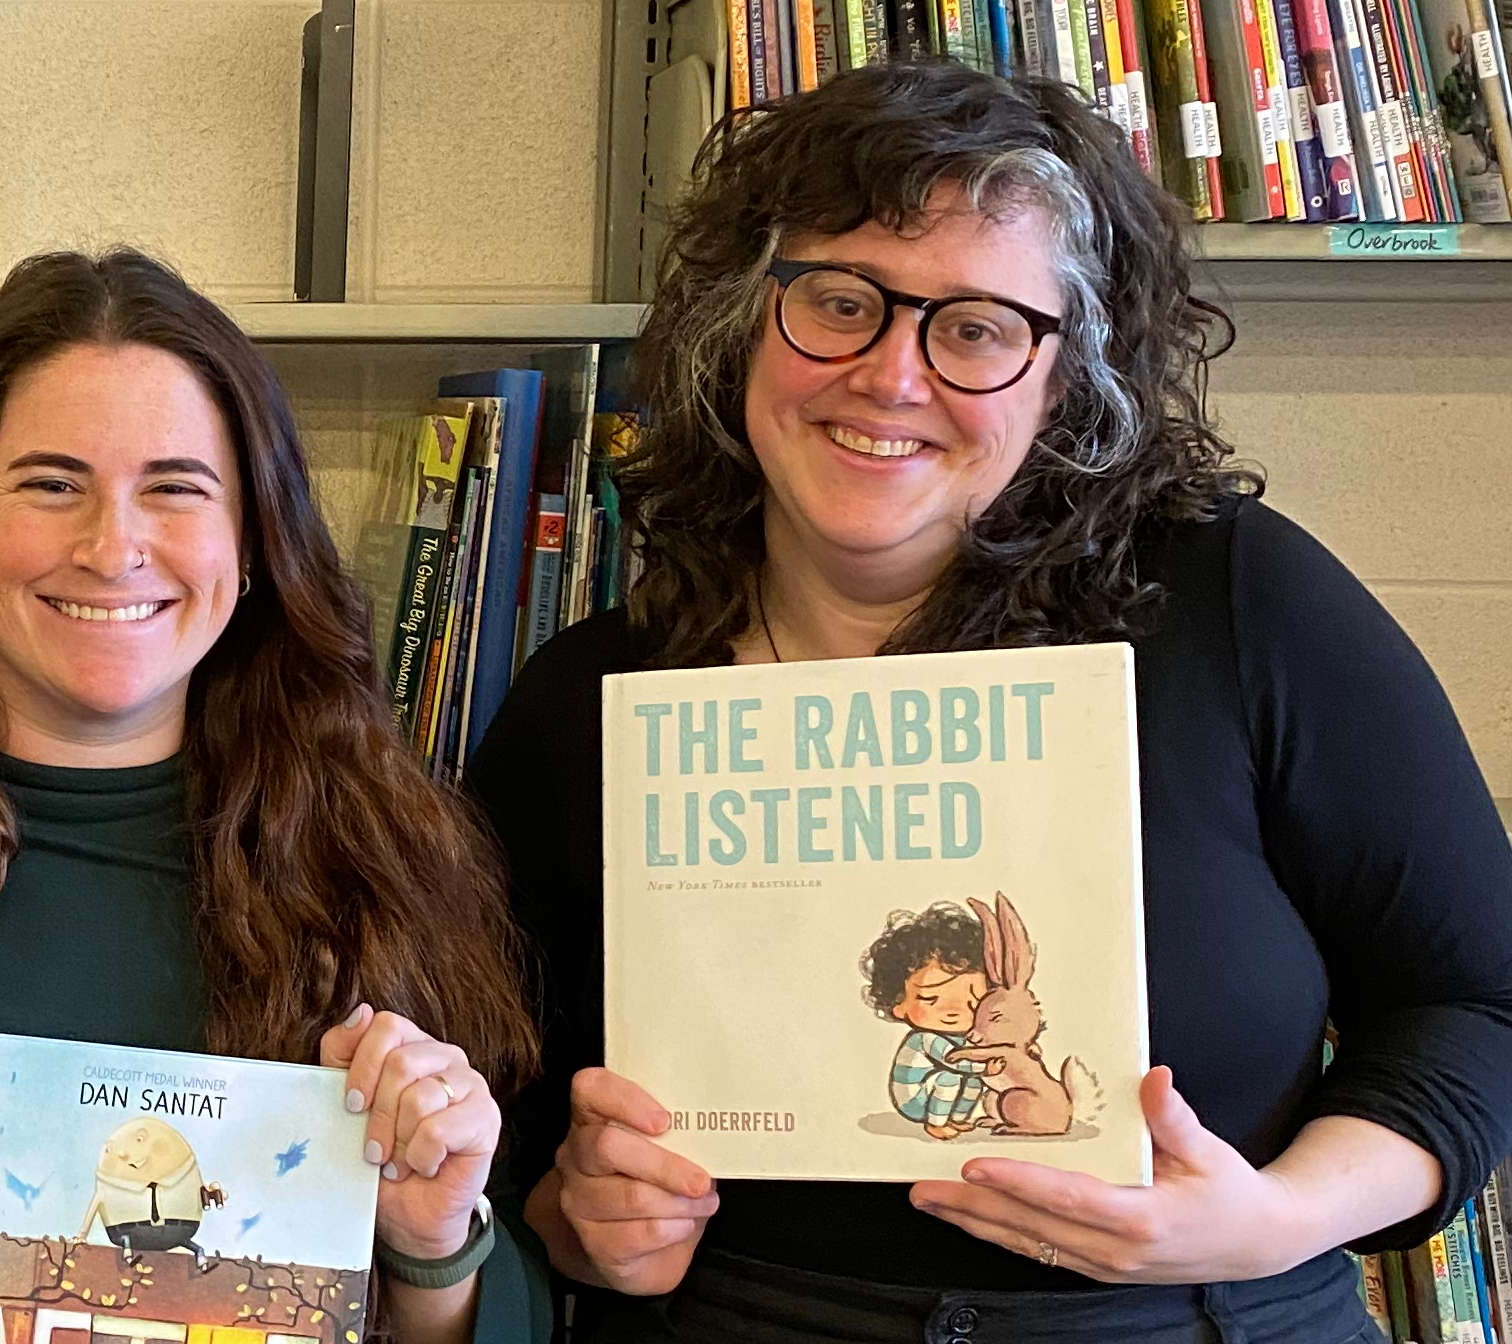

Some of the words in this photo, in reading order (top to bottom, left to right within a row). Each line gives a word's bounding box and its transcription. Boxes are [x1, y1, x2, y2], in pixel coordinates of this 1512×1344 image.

[1191, 108, 1203, 148] HEALTH
[1388, 106, 1403, 147] HEALTH
[1346, 226, 1443, 252] Overbrook
[419, 537, 439, 562] The
[412, 565, 433, 607] Great
[400, 607, 425, 634] Big
[395, 636, 421, 700] Dinosaur
[634, 697, 764, 777] THE
[794, 682, 1055, 770] RABBIT
[645, 782, 983, 867] LISTENED
[678, 879, 708, 890] York
[713, 879, 747, 889] Times
[751, 879, 823, 889] BESTSELLER
[83, 1065, 142, 1085] CALDECOTT
[145, 1071, 179, 1088] MEDAL
[182, 1075, 226, 1091] WINNER
[80, 1082, 128, 1109] DAN
[139, 1088, 227, 1119] SANTAT
[664, 1111, 690, 1131] ORI
[696, 1111, 796, 1132] DOERRFELD
